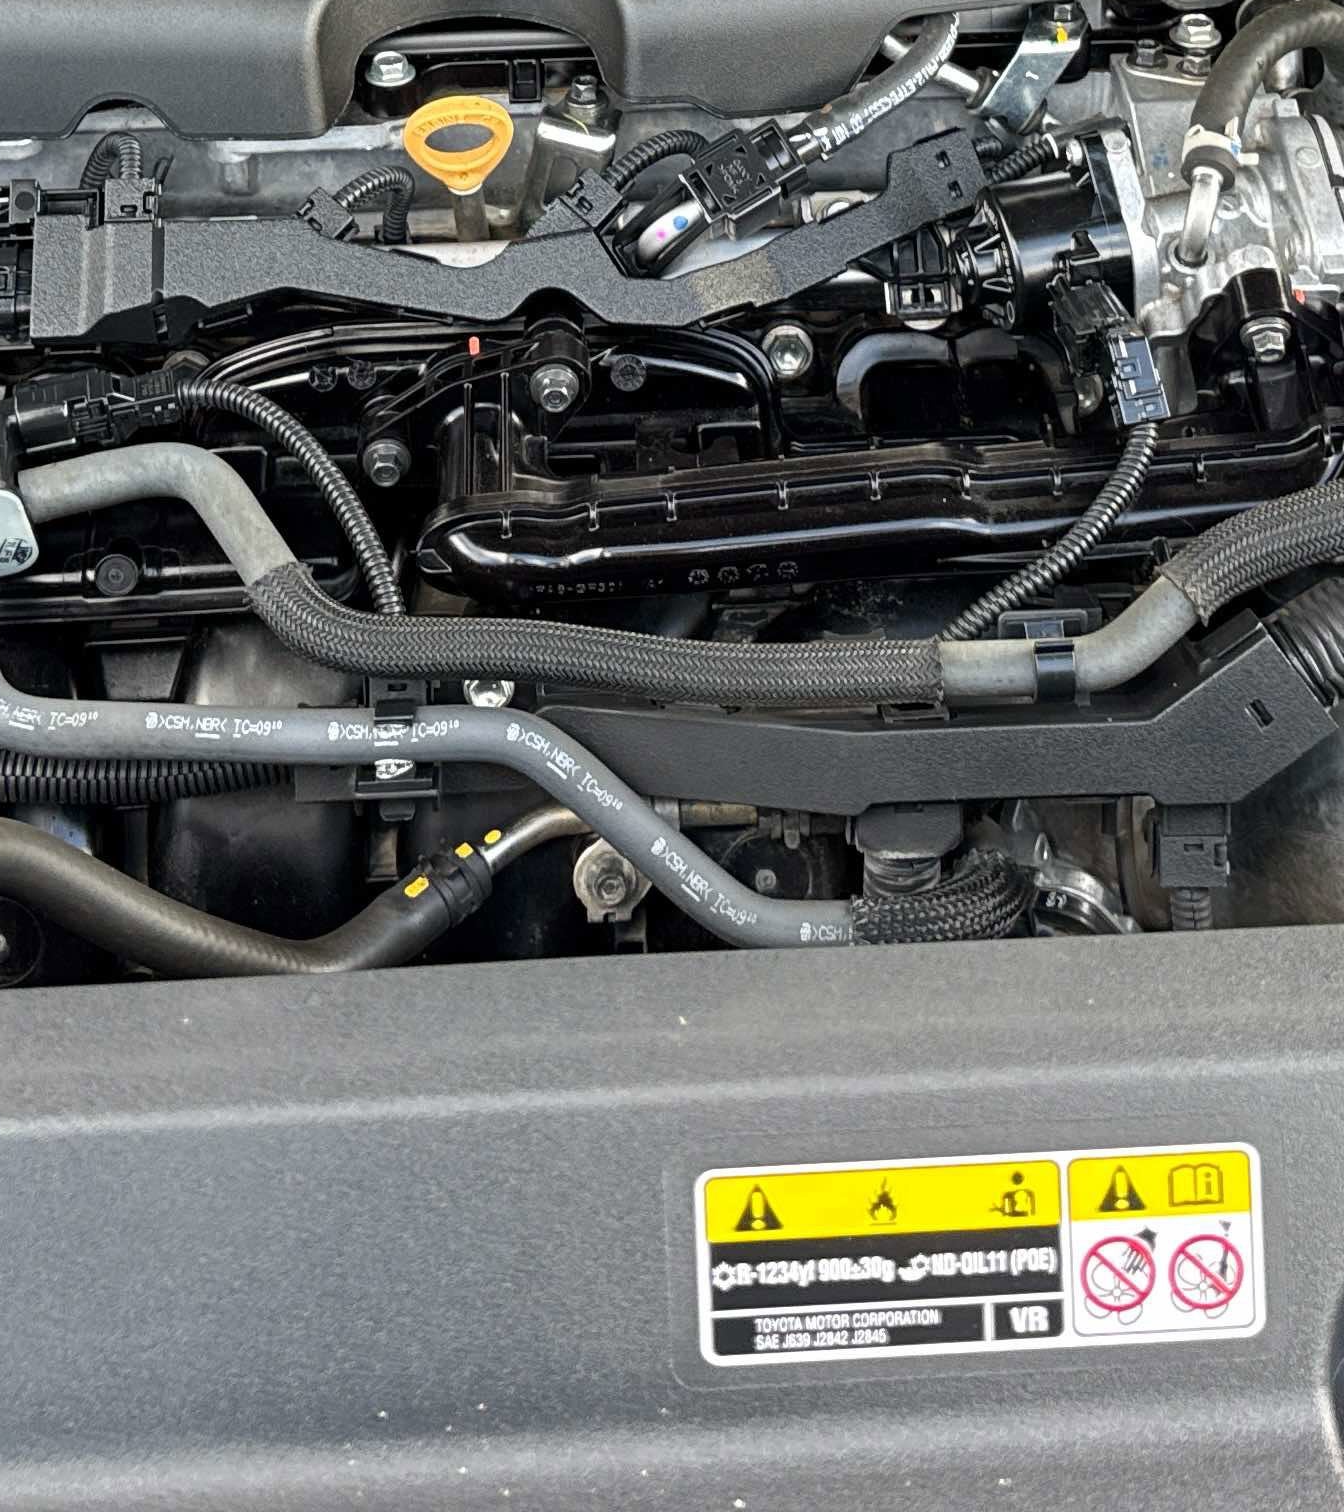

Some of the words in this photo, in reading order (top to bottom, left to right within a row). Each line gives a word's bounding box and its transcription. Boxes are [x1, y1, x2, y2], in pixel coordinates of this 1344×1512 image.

[736, 1258, 816, 1287] R-1234yf
[817, 1255, 896, 1283] 900±30g
[930, 1250, 1008, 1276] ND-OIL11
[1009, 1246, 1057, 1277] (POE)
[755, 1315, 803, 1334] TOYOTA
[805, 1313, 850, 1331] MOTOR
[852, 1308, 942, 1330] CORPORATION
[1009, 1305, 1050, 1334] VR
[754, 1334, 780, 1350] SAE
